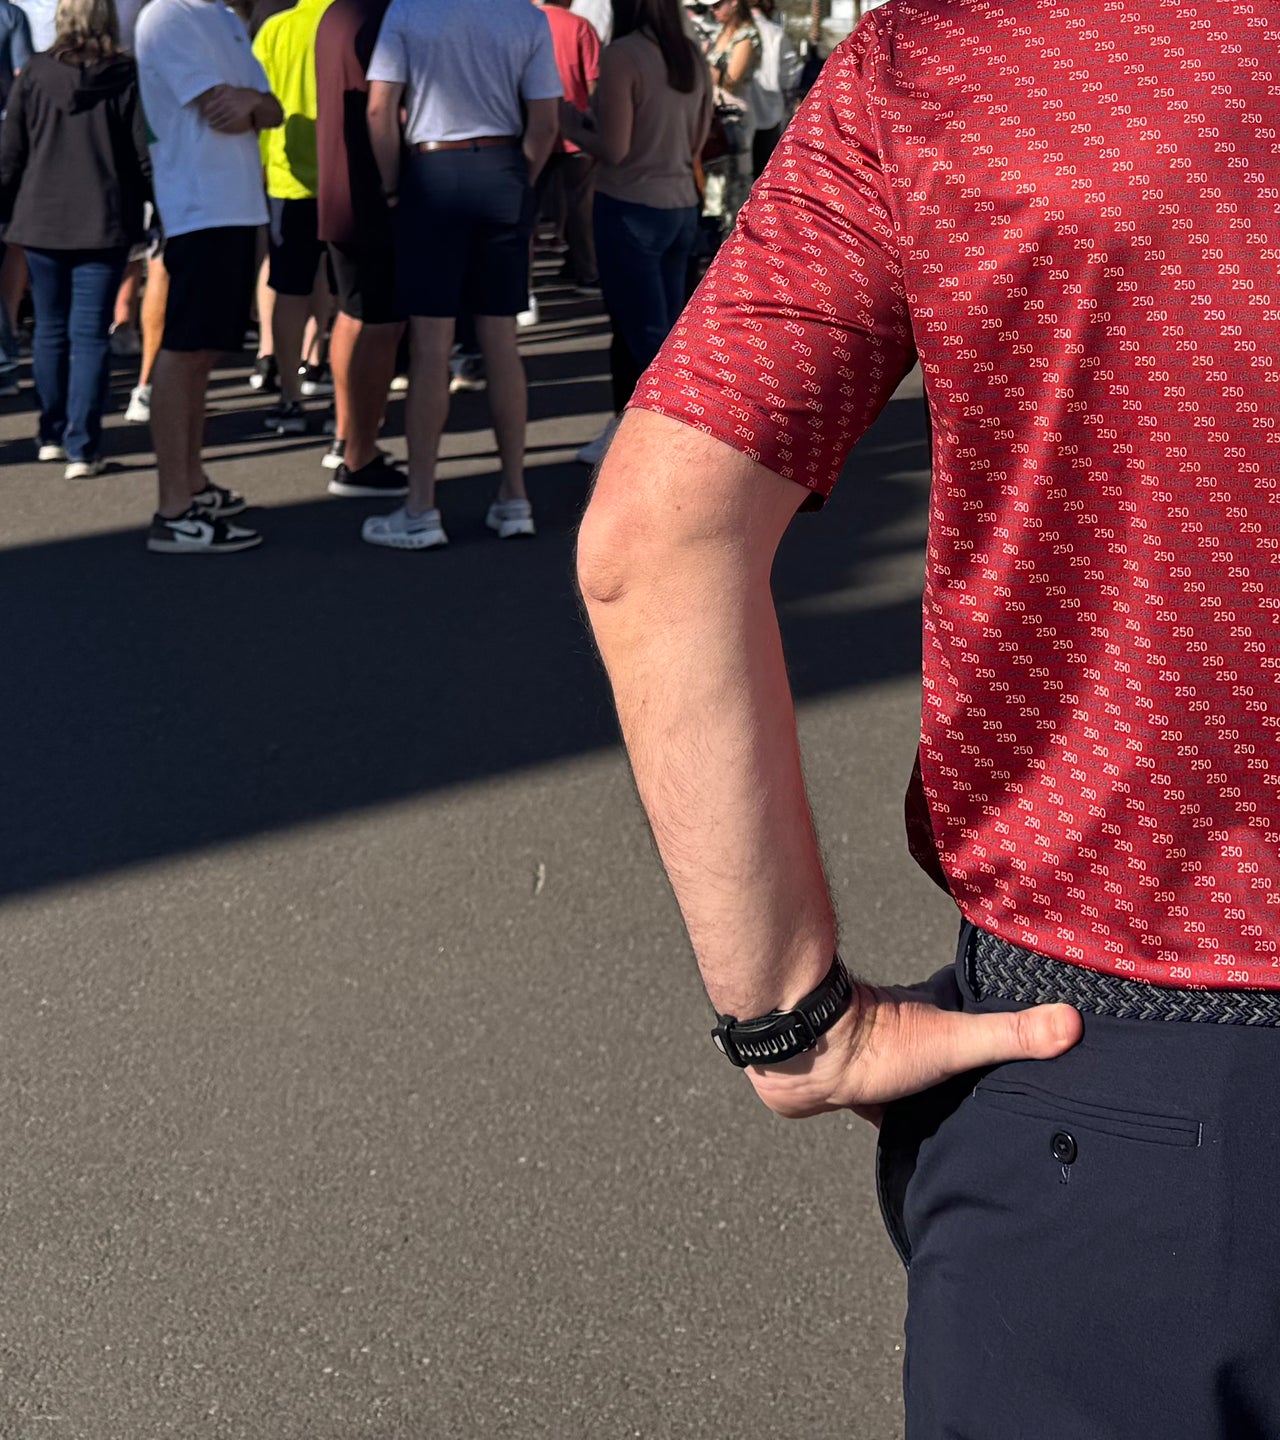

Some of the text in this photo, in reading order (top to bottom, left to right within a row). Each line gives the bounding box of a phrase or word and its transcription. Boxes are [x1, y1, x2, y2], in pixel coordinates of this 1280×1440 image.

[1103, 1, 1125, 12] 250
[1179, 58, 1202, 70] 250
[1026, 87, 1048, 99] 250
[917, 147, 939, 158] 250
[1155, 142, 1178, 155] 250
[1070, 178, 1093, 190] 250
[1243, 172, 1265, 184] 250
[825, 199, 845, 214] 250
[990, 214, 1011, 226] 250
[801, 242, 822, 258] 250
[1144, 249, 1166, 261] 250
[844, 249, 866, 268] 250
[1048, 269, 1070, 281] 250
[1231, 278, 1254, 290] 250
[772, 289, 794, 306] 250
[816, 298, 837, 316] 250
[913, 307, 934, 318] 250
[1146, 310, 1168, 322] 250
[742, 317, 763, 332] 250
[791, 340, 812, 357] 250
[832, 346, 851, 362] 250
[1064, 343, 1085, 355] 250
[709, 350, 730, 365] 250
[1191, 355, 1214, 367] 250
[757, 372, 780, 389] 250
[987, 374, 1009, 386] 250
[801, 379, 822, 395] 250
[683, 401, 705, 417] 250
[1137, 415, 1158, 427] 250
[733, 424, 755, 442] 250
[1207, 431, 1230, 443] 250
[955, 447, 977, 459] 250
[1071, 456, 1093, 469] 250
[1167, 506, 1190, 518] 250
[1022, 517, 1043, 528] 250
[1069, 556, 1091, 567] 250
[947, 579, 967, 590] 250
[1183, 581, 1206, 593] 250
[1004, 601, 1026, 612] 250
[1186, 641, 1208, 653] 250
[1066, 652, 1088, 664] 250
[975, 667, 996, 679] 250
[1035, 719, 1057, 730] 250
[1233, 743, 1256, 755] 250
[973, 757, 994, 768] 250
[1163, 789, 1186, 801] 250
[1193, 875, 1216, 887] 250
[1169, 965, 1192, 980] 250
